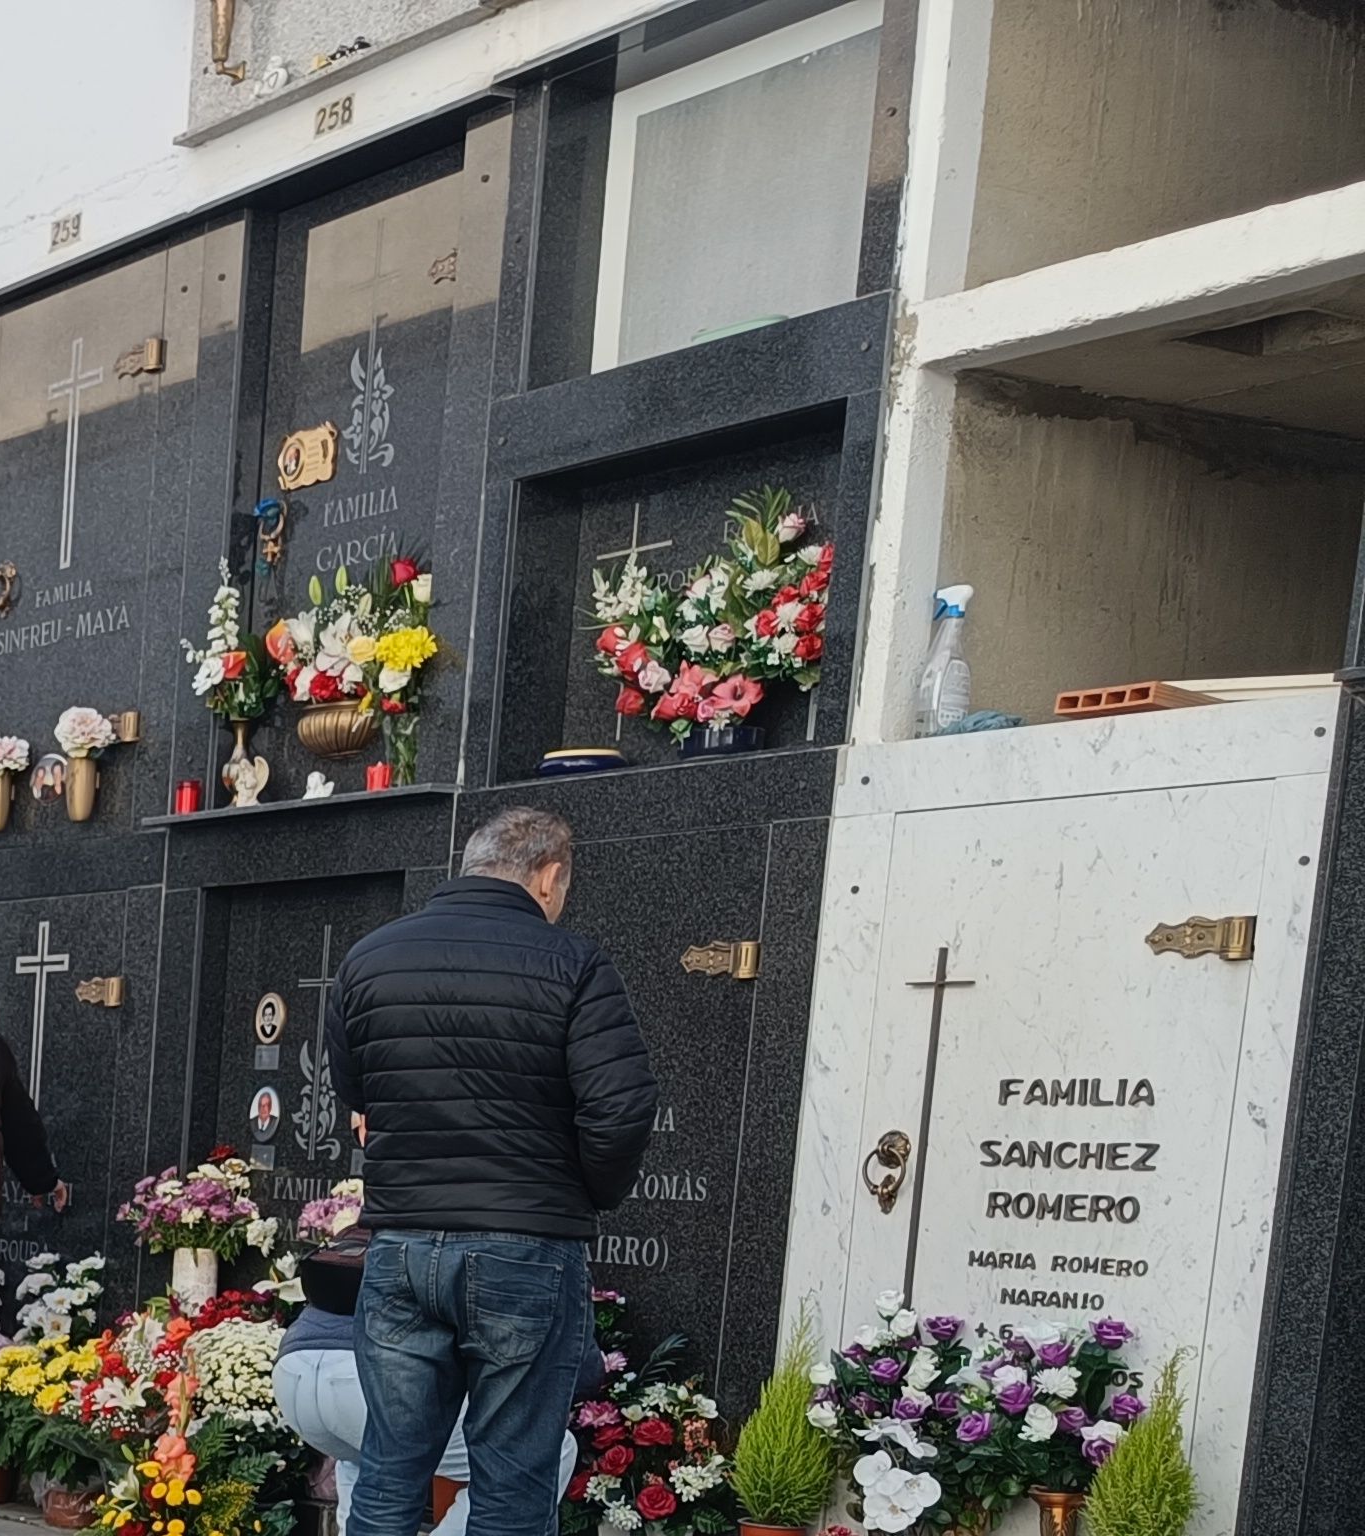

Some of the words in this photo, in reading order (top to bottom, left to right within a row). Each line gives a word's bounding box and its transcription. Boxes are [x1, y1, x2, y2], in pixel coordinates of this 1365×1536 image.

[315, 96, 353, 135] 258
[52, 212, 81, 246] 259
[323, 486, 398, 527] FAMILIA
[316, 525, 399, 572] GARCÍA
[35, 580, 93, 608] FAMILIA
[998, 1078, 1156, 1107] FAMILIA
[979, 1140, 1161, 1172] SANCHEZ
[273, 1177, 332, 1200] FAMILI
[985, 1191, 1141, 1224] ROMERO
[969, 1250, 1036, 1270] MARIA
[1050, 1255, 1149, 1277] ROMERO
